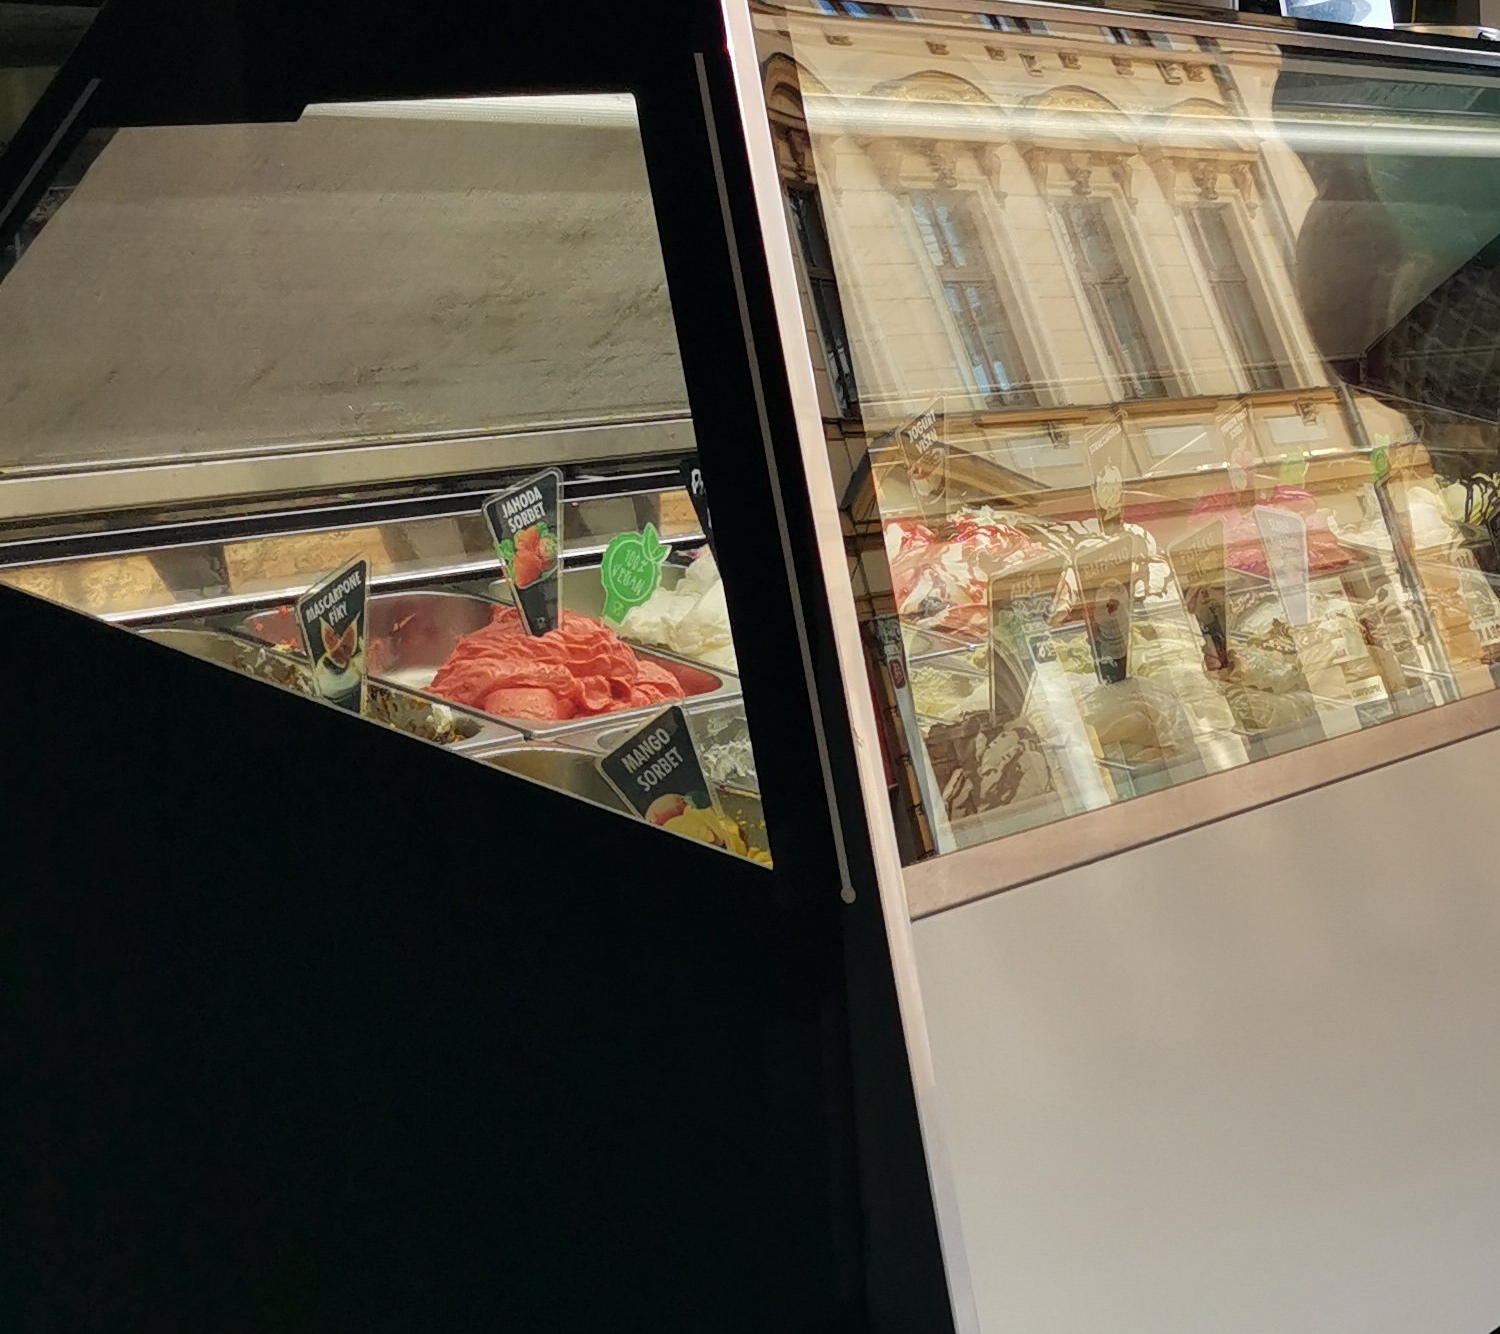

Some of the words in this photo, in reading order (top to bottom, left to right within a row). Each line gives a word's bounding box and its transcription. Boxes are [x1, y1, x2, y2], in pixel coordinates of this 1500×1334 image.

[502, 486, 543, 518] JAHODA
[508, 501, 546, 533] SORBET
[305, 570, 362, 624] MASCARPONE
[621, 728, 671, 774] MANGO
[637, 747, 684, 792] SORBET
